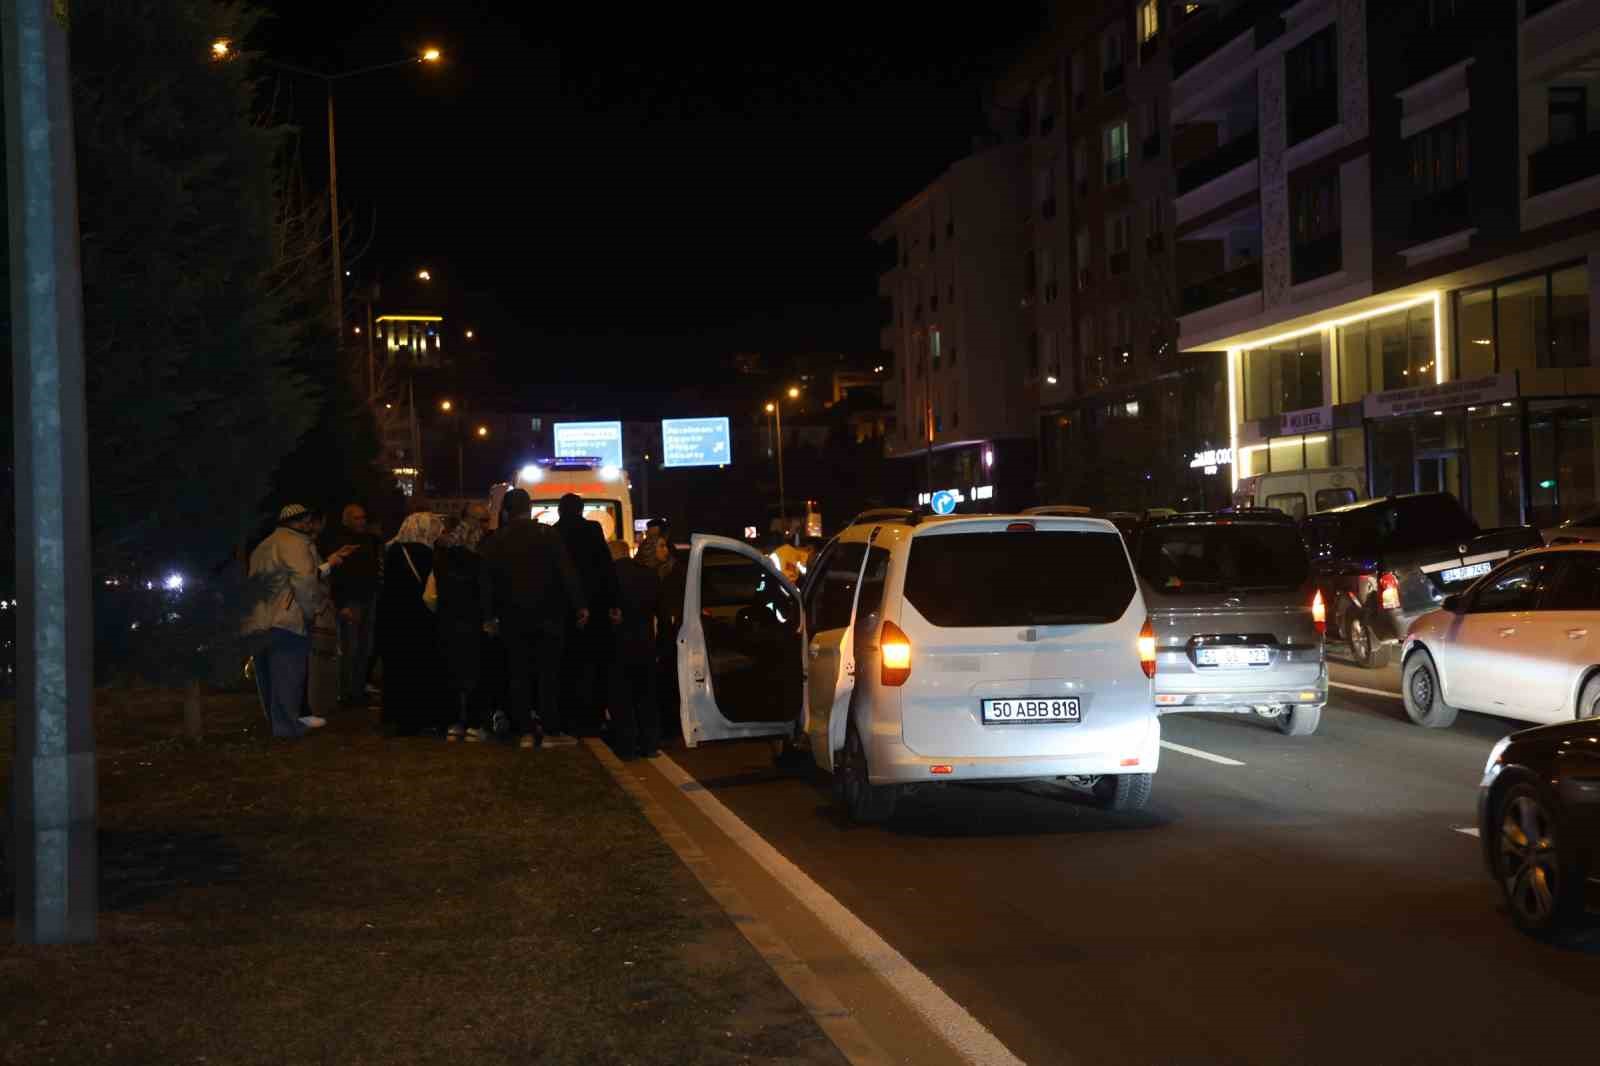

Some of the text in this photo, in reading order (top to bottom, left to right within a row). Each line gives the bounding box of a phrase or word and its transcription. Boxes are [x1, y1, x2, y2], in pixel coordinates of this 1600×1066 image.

[993, 701, 1078, 718] 50 ABB 818
